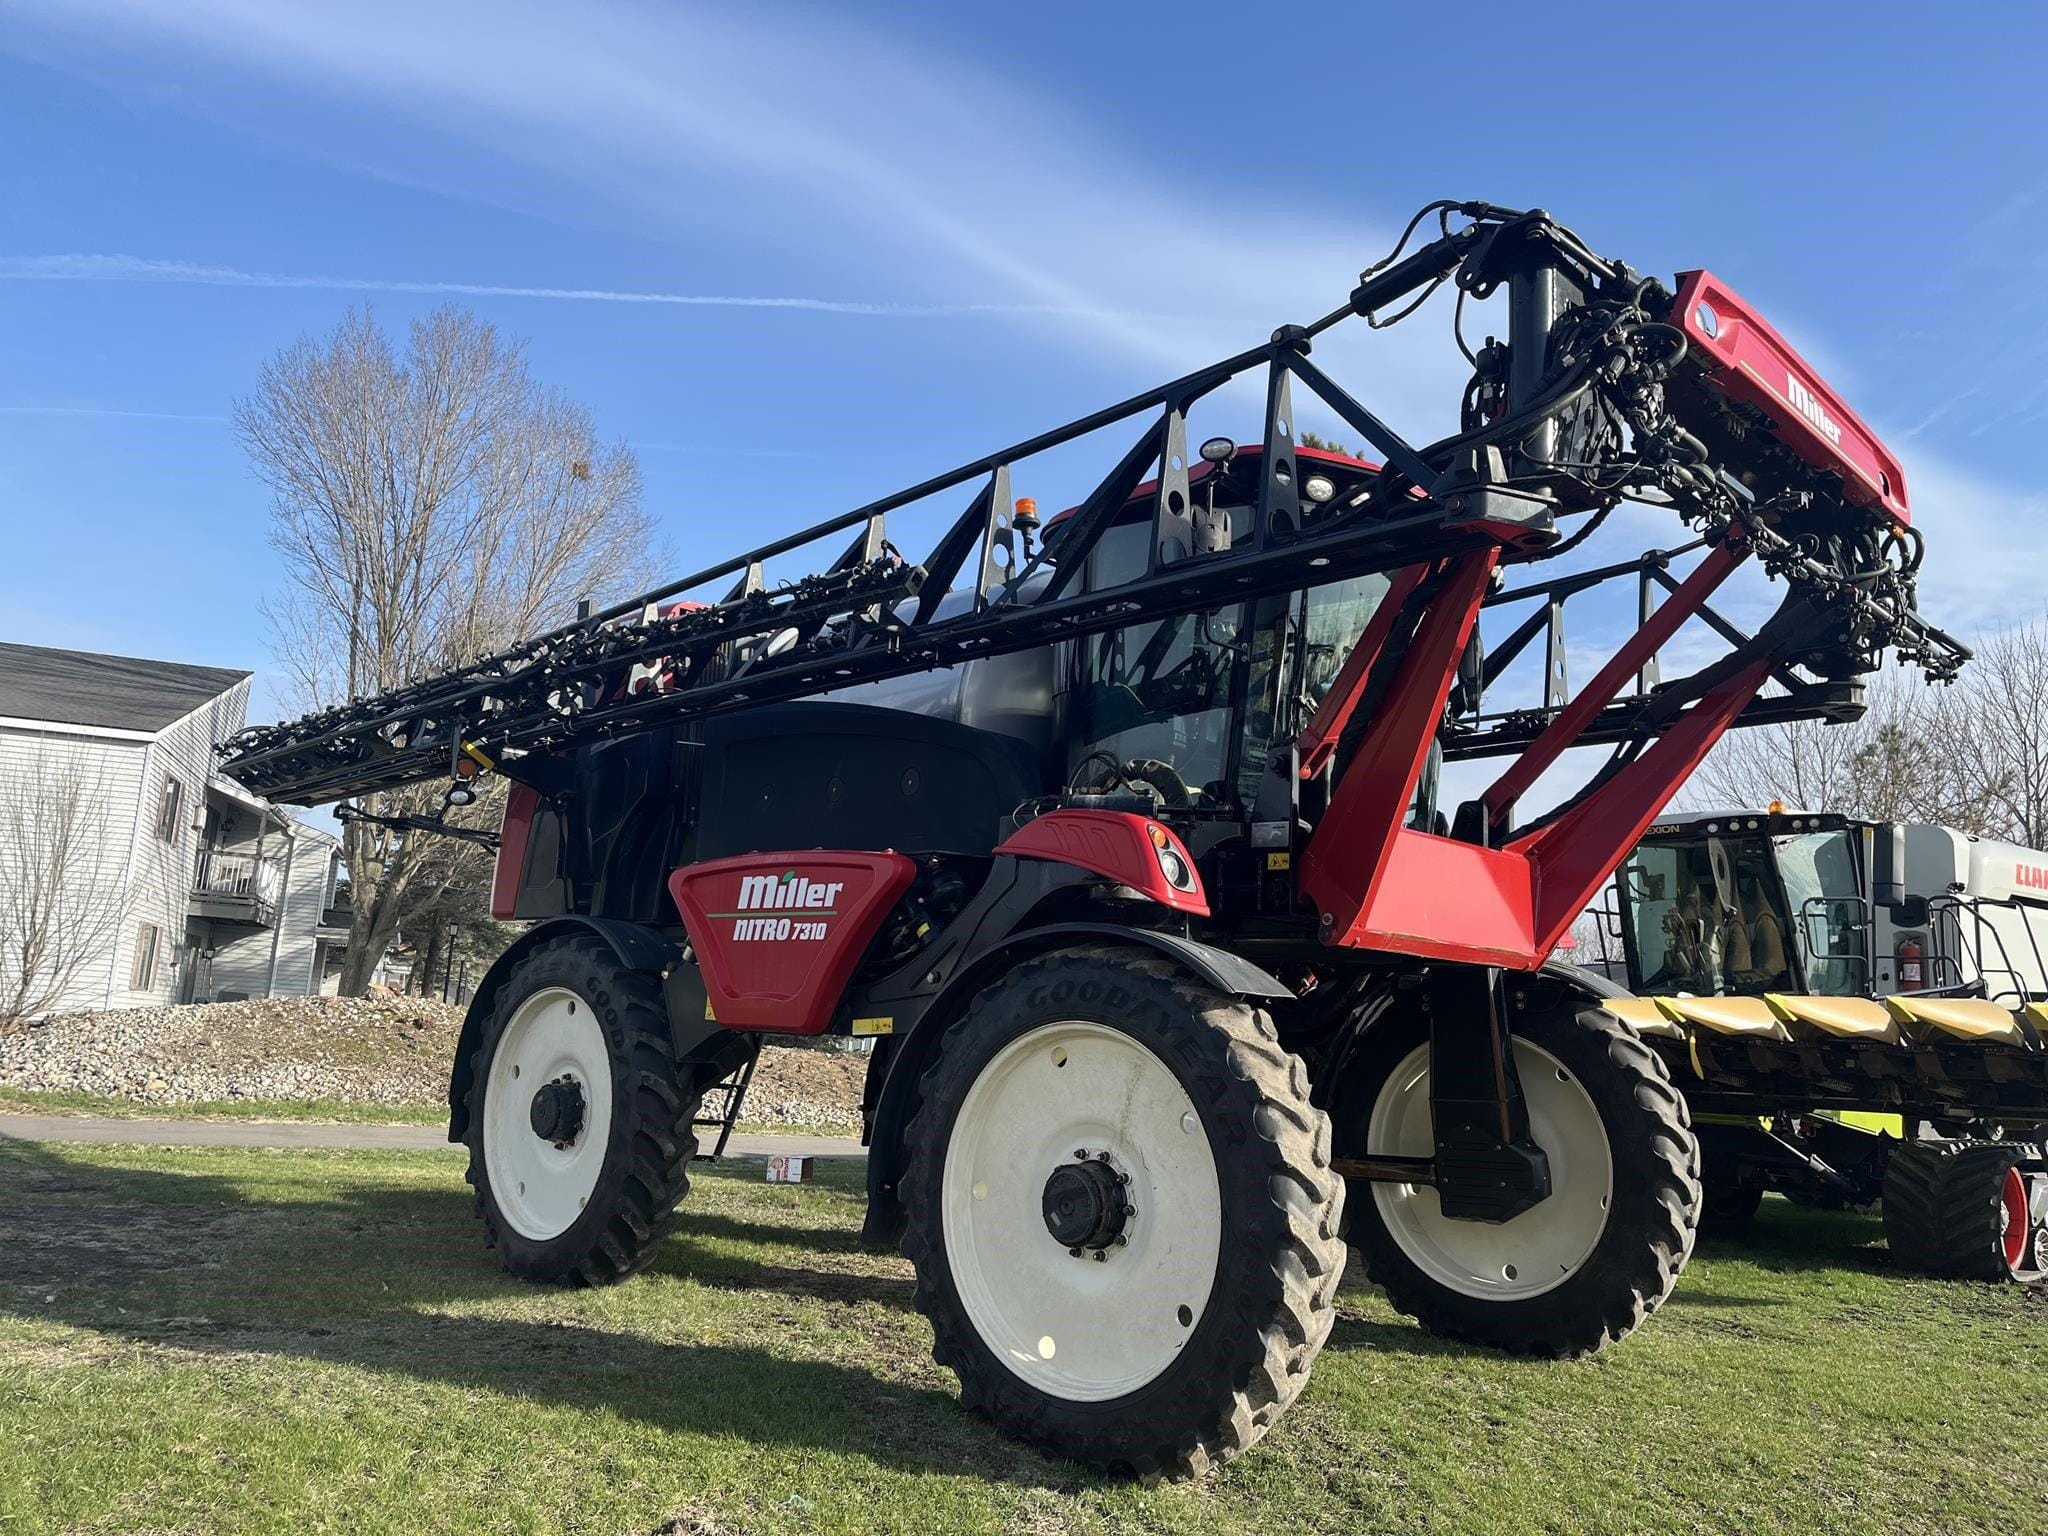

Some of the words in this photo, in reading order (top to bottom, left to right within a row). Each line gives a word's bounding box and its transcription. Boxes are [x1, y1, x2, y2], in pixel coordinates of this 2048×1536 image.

[1786, 371, 1841, 445] Miller
[1645, 825, 1680, 835] EXION
[737, 873, 844, 909] Miller
[733, 919, 790, 942] NITRO
[791, 922, 827, 941] 7310
